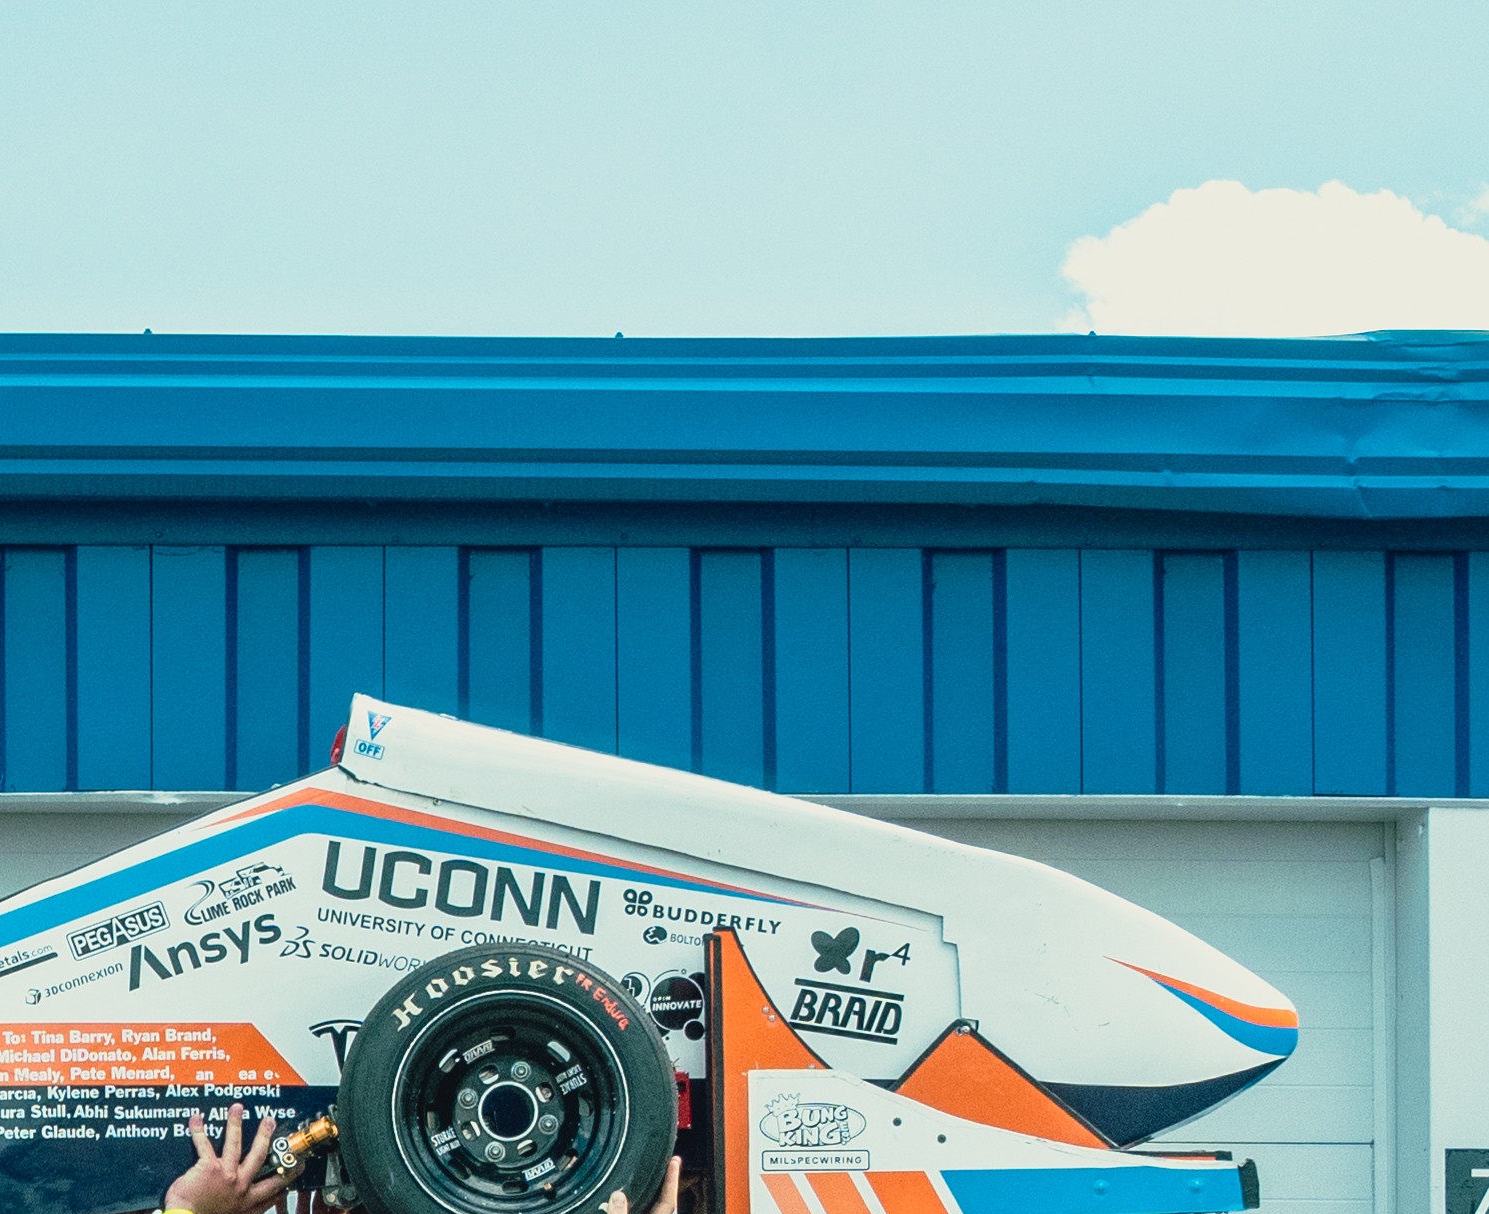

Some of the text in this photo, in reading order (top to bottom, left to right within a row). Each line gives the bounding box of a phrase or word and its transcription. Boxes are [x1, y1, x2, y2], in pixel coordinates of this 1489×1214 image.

[358, 742, 381, 756] OFF
[201, 877, 297, 922] LIME ROCK PARK
[322, 841, 602, 936] UCONN
[72, 905, 163, 956] PEGASUS
[317, 907, 425, 937] UNIVERSITY
[430, 925, 456, 942] OF
[653, 904, 782, 935] BUDDERFLY
[129, 913, 282, 991] Ansys
[671, 934, 705, 946] BOLTO
[319, 943, 427, 972] SOLIDWOR
[392, 956, 576, 1032] Hoosier
[652, 1000, 702, 1012] INNOVATE
[790, 988, 904, 1036] BRAID
[2, 1030, 27, 1045] To:
[31, 1030, 64, 1044] Tina
[69, 1030, 116, 1046] Barry,
[121, 1029, 160, 1046] Ryan
[165, 1028, 217, 1043] Brand,
[60, 1048, 137, 1064] DiDonato,
[142, 1047, 176, 1061] Alan
[180, 1047, 231, 1062] Ferris,
[13, 1068, 66, 1084] Mealy,
[70, 1067, 107, 1081] Pete
[111, 1066, 175, 1082] Menard,
[47, 1086, 99, 1102] Kylene
[104, 1085, 161, 1100] Perras,
[165, 1084, 199, 1098] Alex
[204, 1083, 281, 1099] Podgorski
[30, 1104, 72, 1119] Stull,
[73, 1105, 109, 1119] Abhi
[114, 1105, 205, 1121] Sukumaran,
[254, 1105, 296, 1119] Wyse
[777, 1104, 849, 1133] BUNG
[41, 1125, 100, 1141] Glaude,
[105, 1124, 169, 1140] Anthony
[173, 1124, 224, 1140] Betty
[779, 1121, 843, 1147] KING
